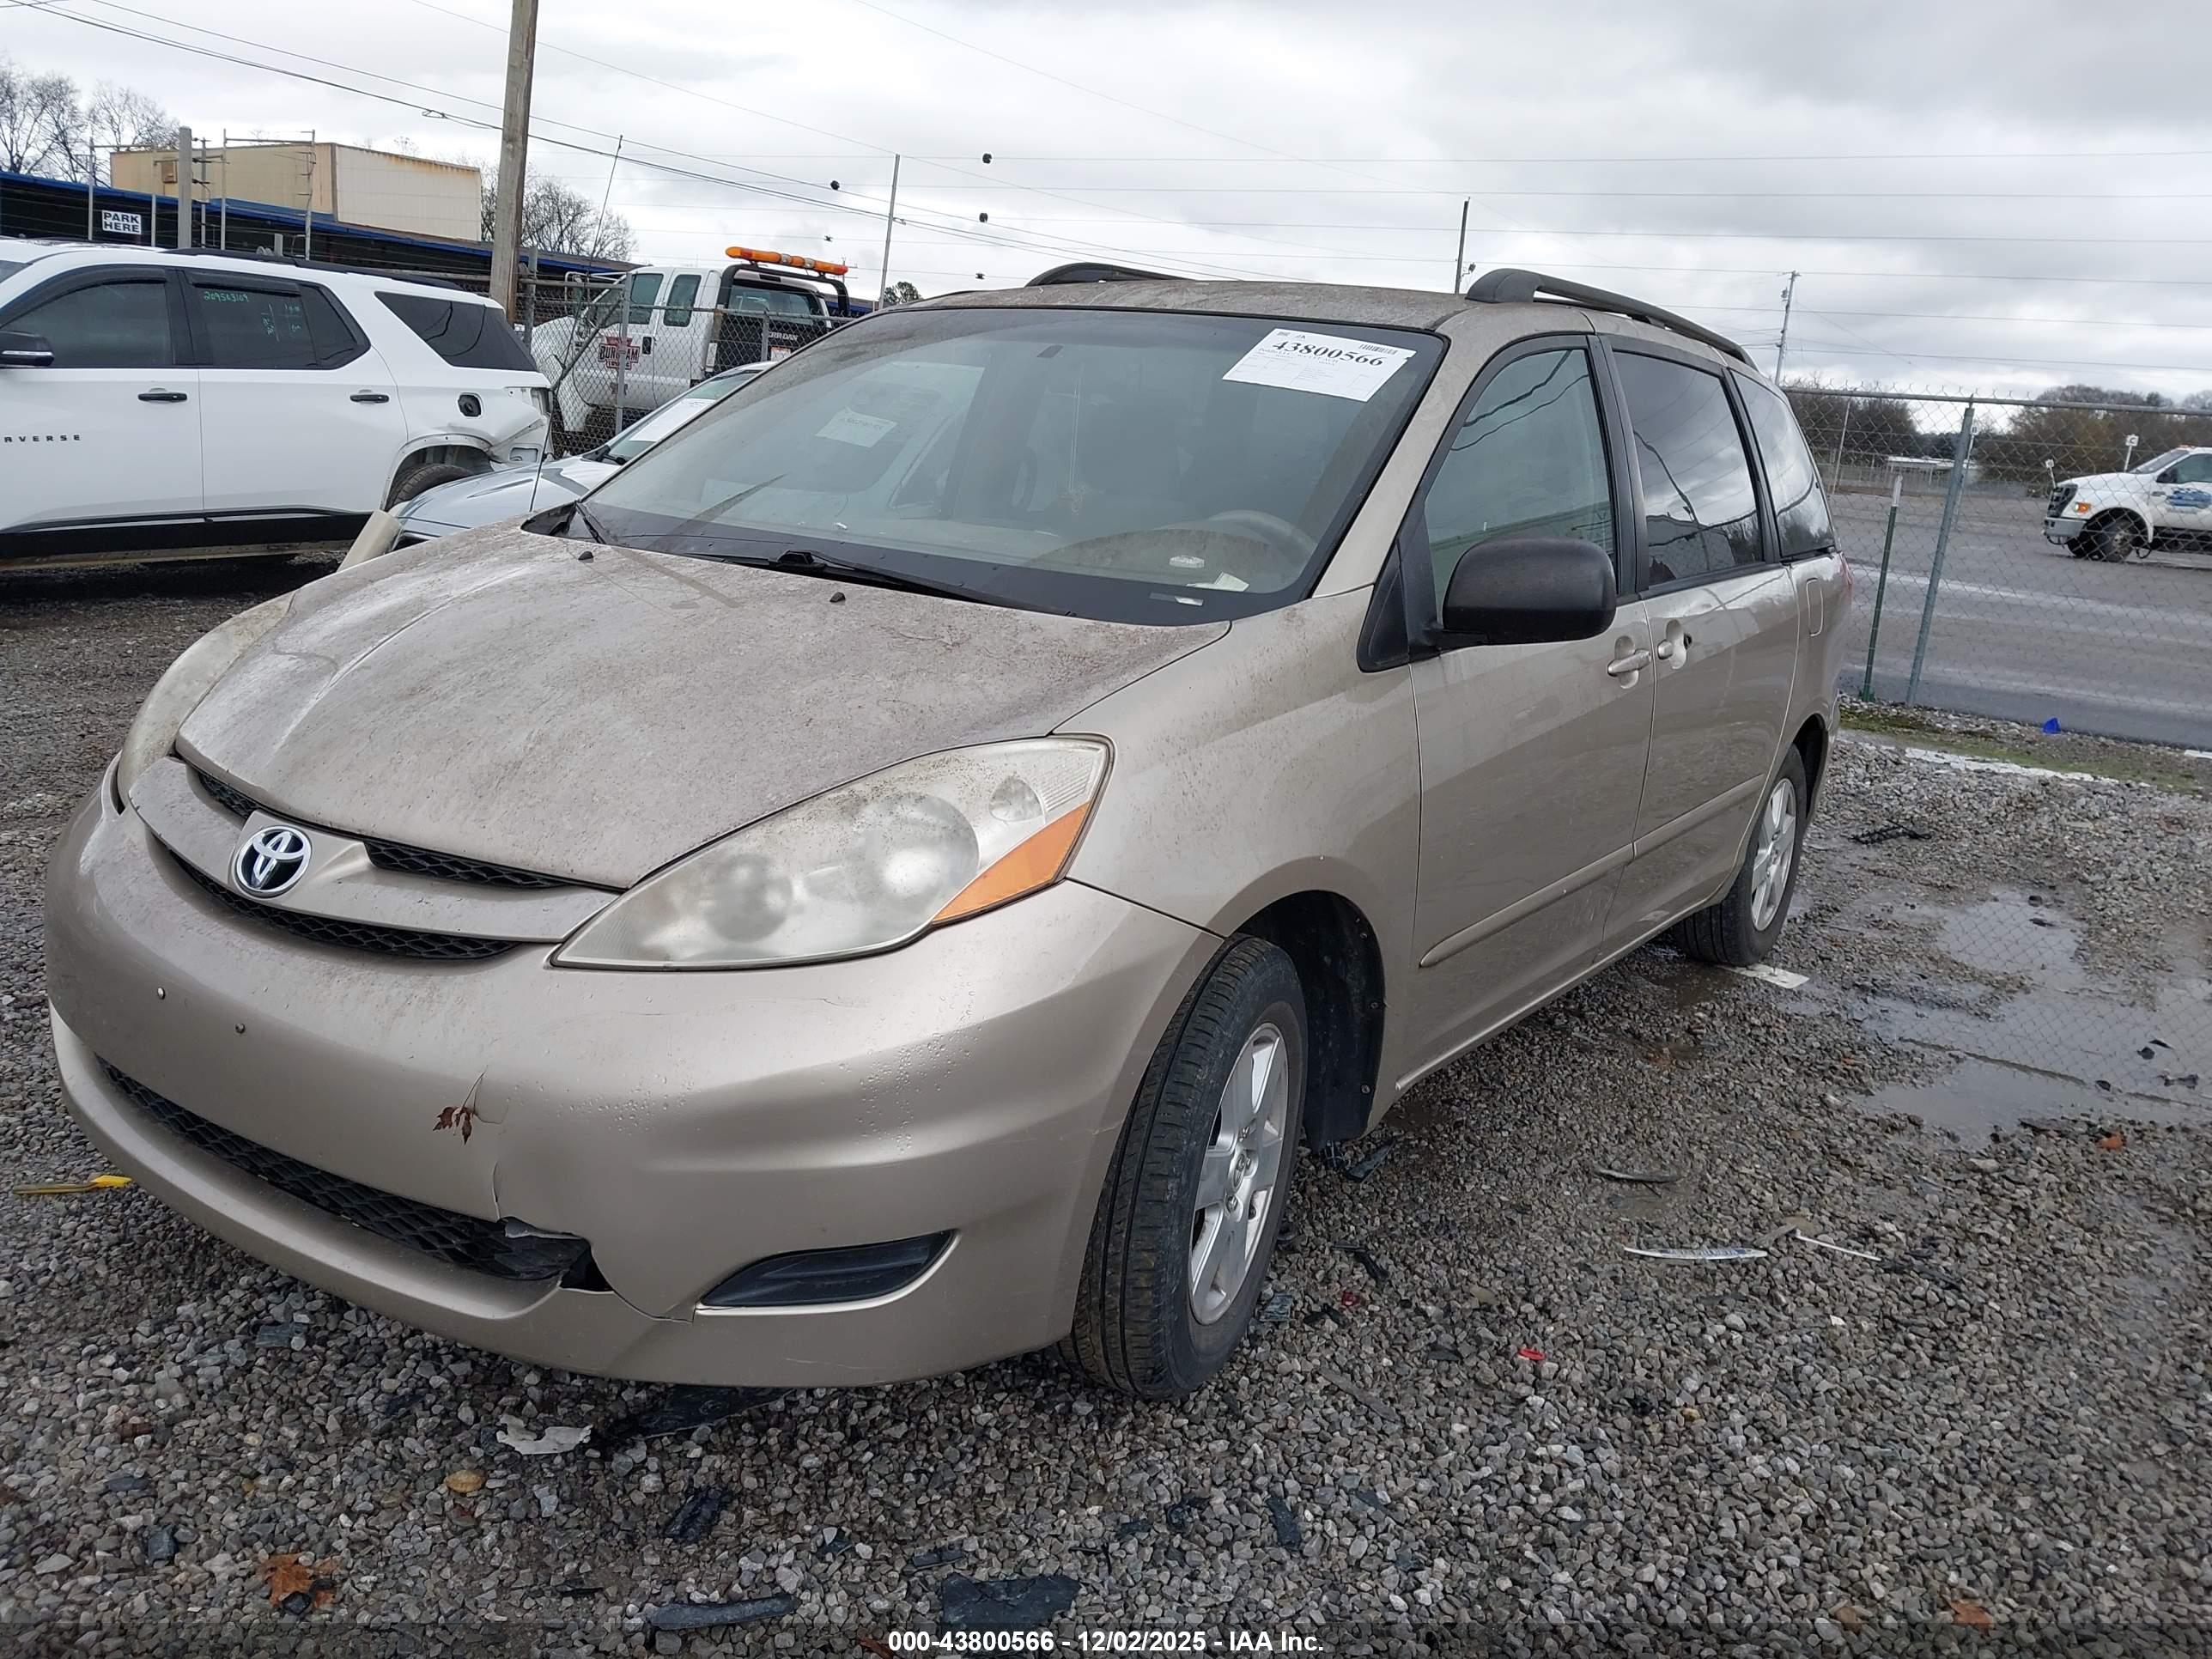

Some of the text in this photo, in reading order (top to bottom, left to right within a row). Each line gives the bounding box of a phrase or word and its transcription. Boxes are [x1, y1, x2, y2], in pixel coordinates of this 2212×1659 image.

[104, 212, 139, 223] PARK
[104, 221, 139, 233] HERE
[1272, 340, 1389, 367] 43800566
